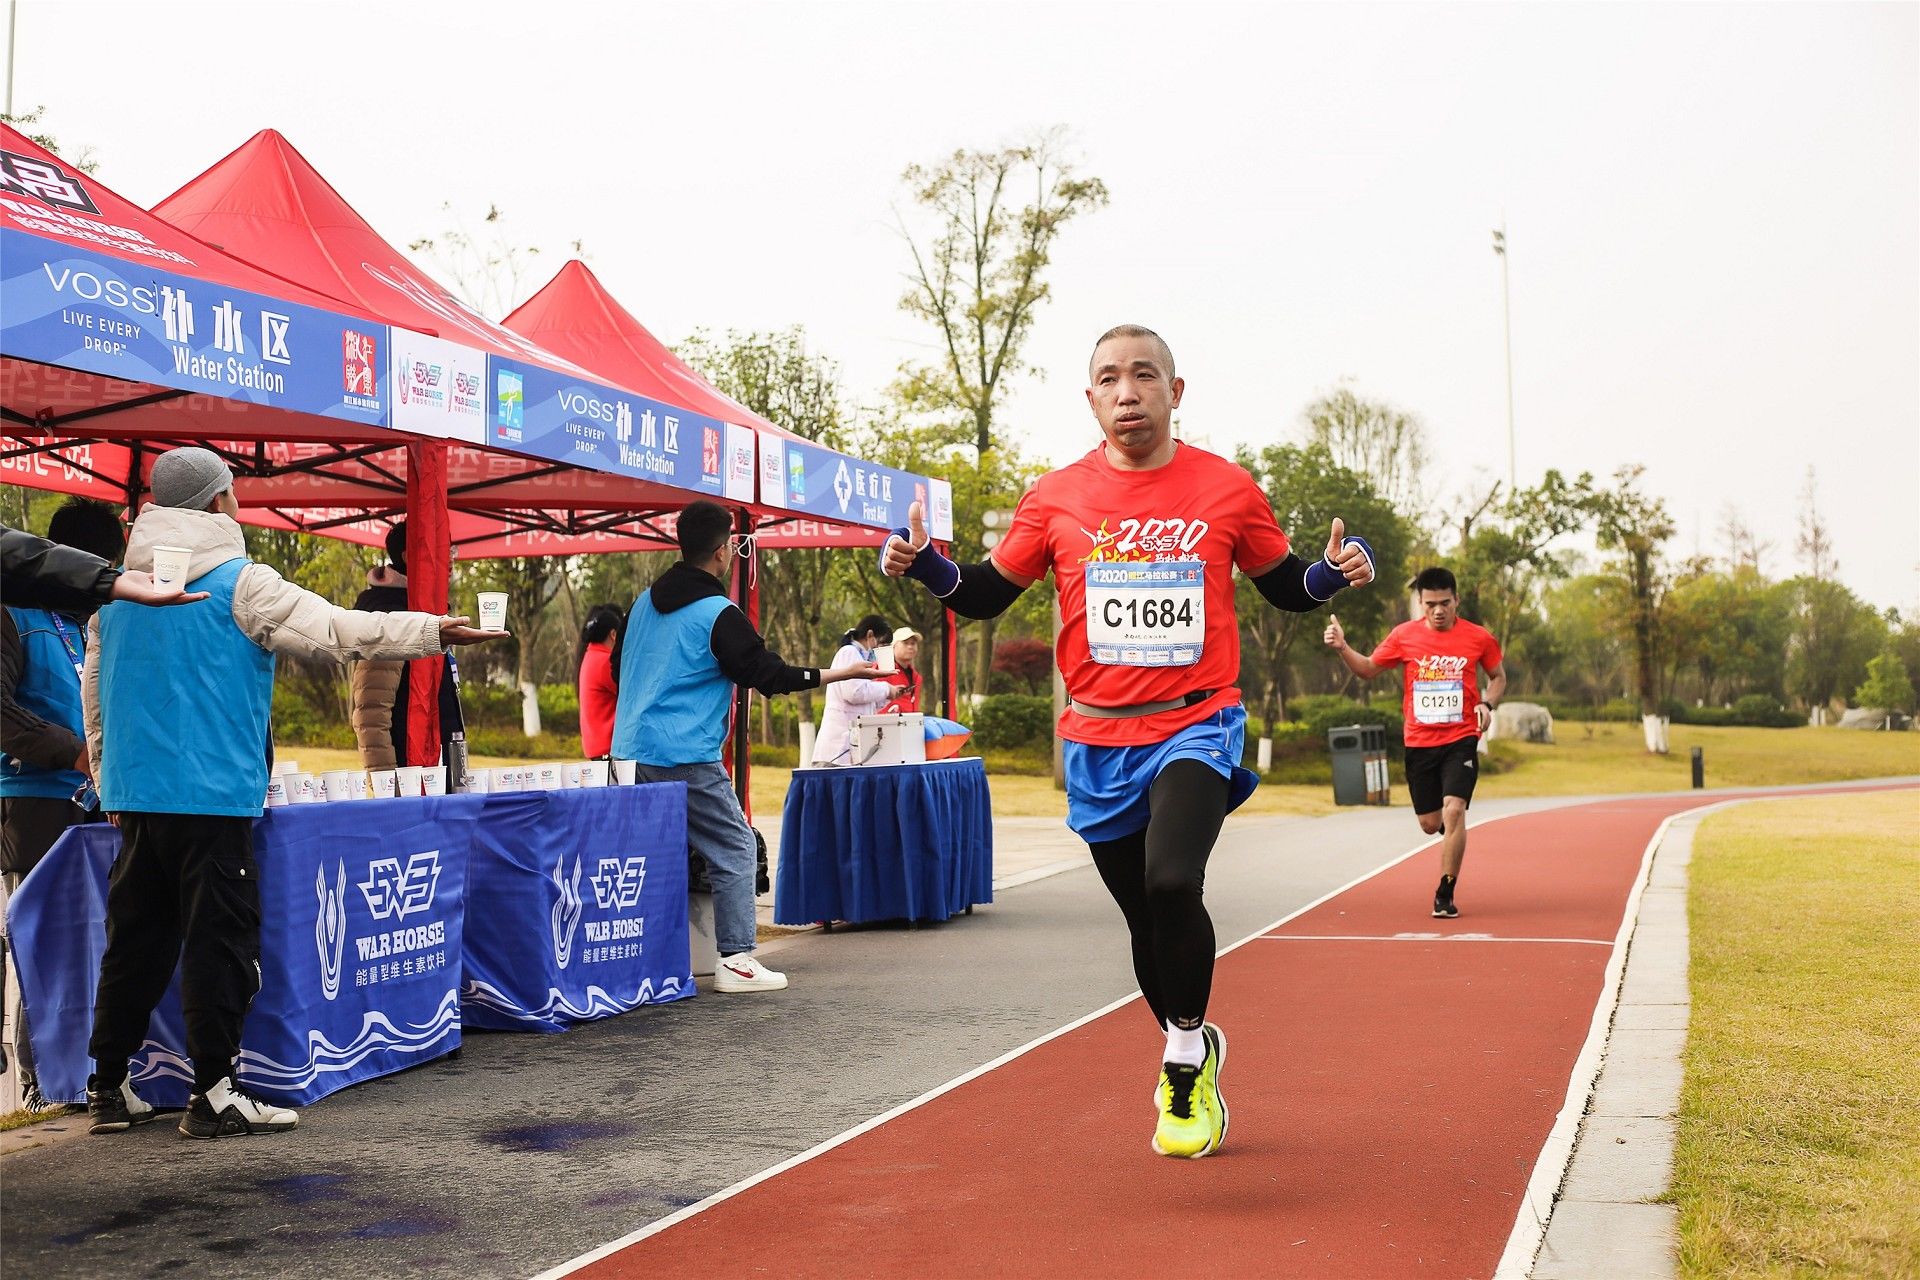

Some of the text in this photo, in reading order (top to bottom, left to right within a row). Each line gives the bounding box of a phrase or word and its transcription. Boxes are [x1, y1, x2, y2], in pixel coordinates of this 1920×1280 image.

[44, 262, 155, 314] VOSS
[63, 309, 141, 340] LIVE EVERY
[160, 285, 291, 366] 补水区
[172, 345, 284, 394] Water Station
[558, 390, 614, 422] VOSS
[566, 422, 606, 441] LIVE EVERY
[616, 400, 680, 455] 补水区
[620, 443, 645, 469] Water
[645, 449, 675, 476] Station
[855, 467, 893, 503] 医疗区
[863, 501, 887, 524] First Aid
[1116, 517, 1208, 553] 2020
[1103, 598, 1193, 628] C1684
[1421, 695, 1459, 708] C1219
[356, 920, 445, 962] WAR HORSE
[584, 920, 611, 943] WAR
[356, 949, 446, 987] 能量型维生素饮料
